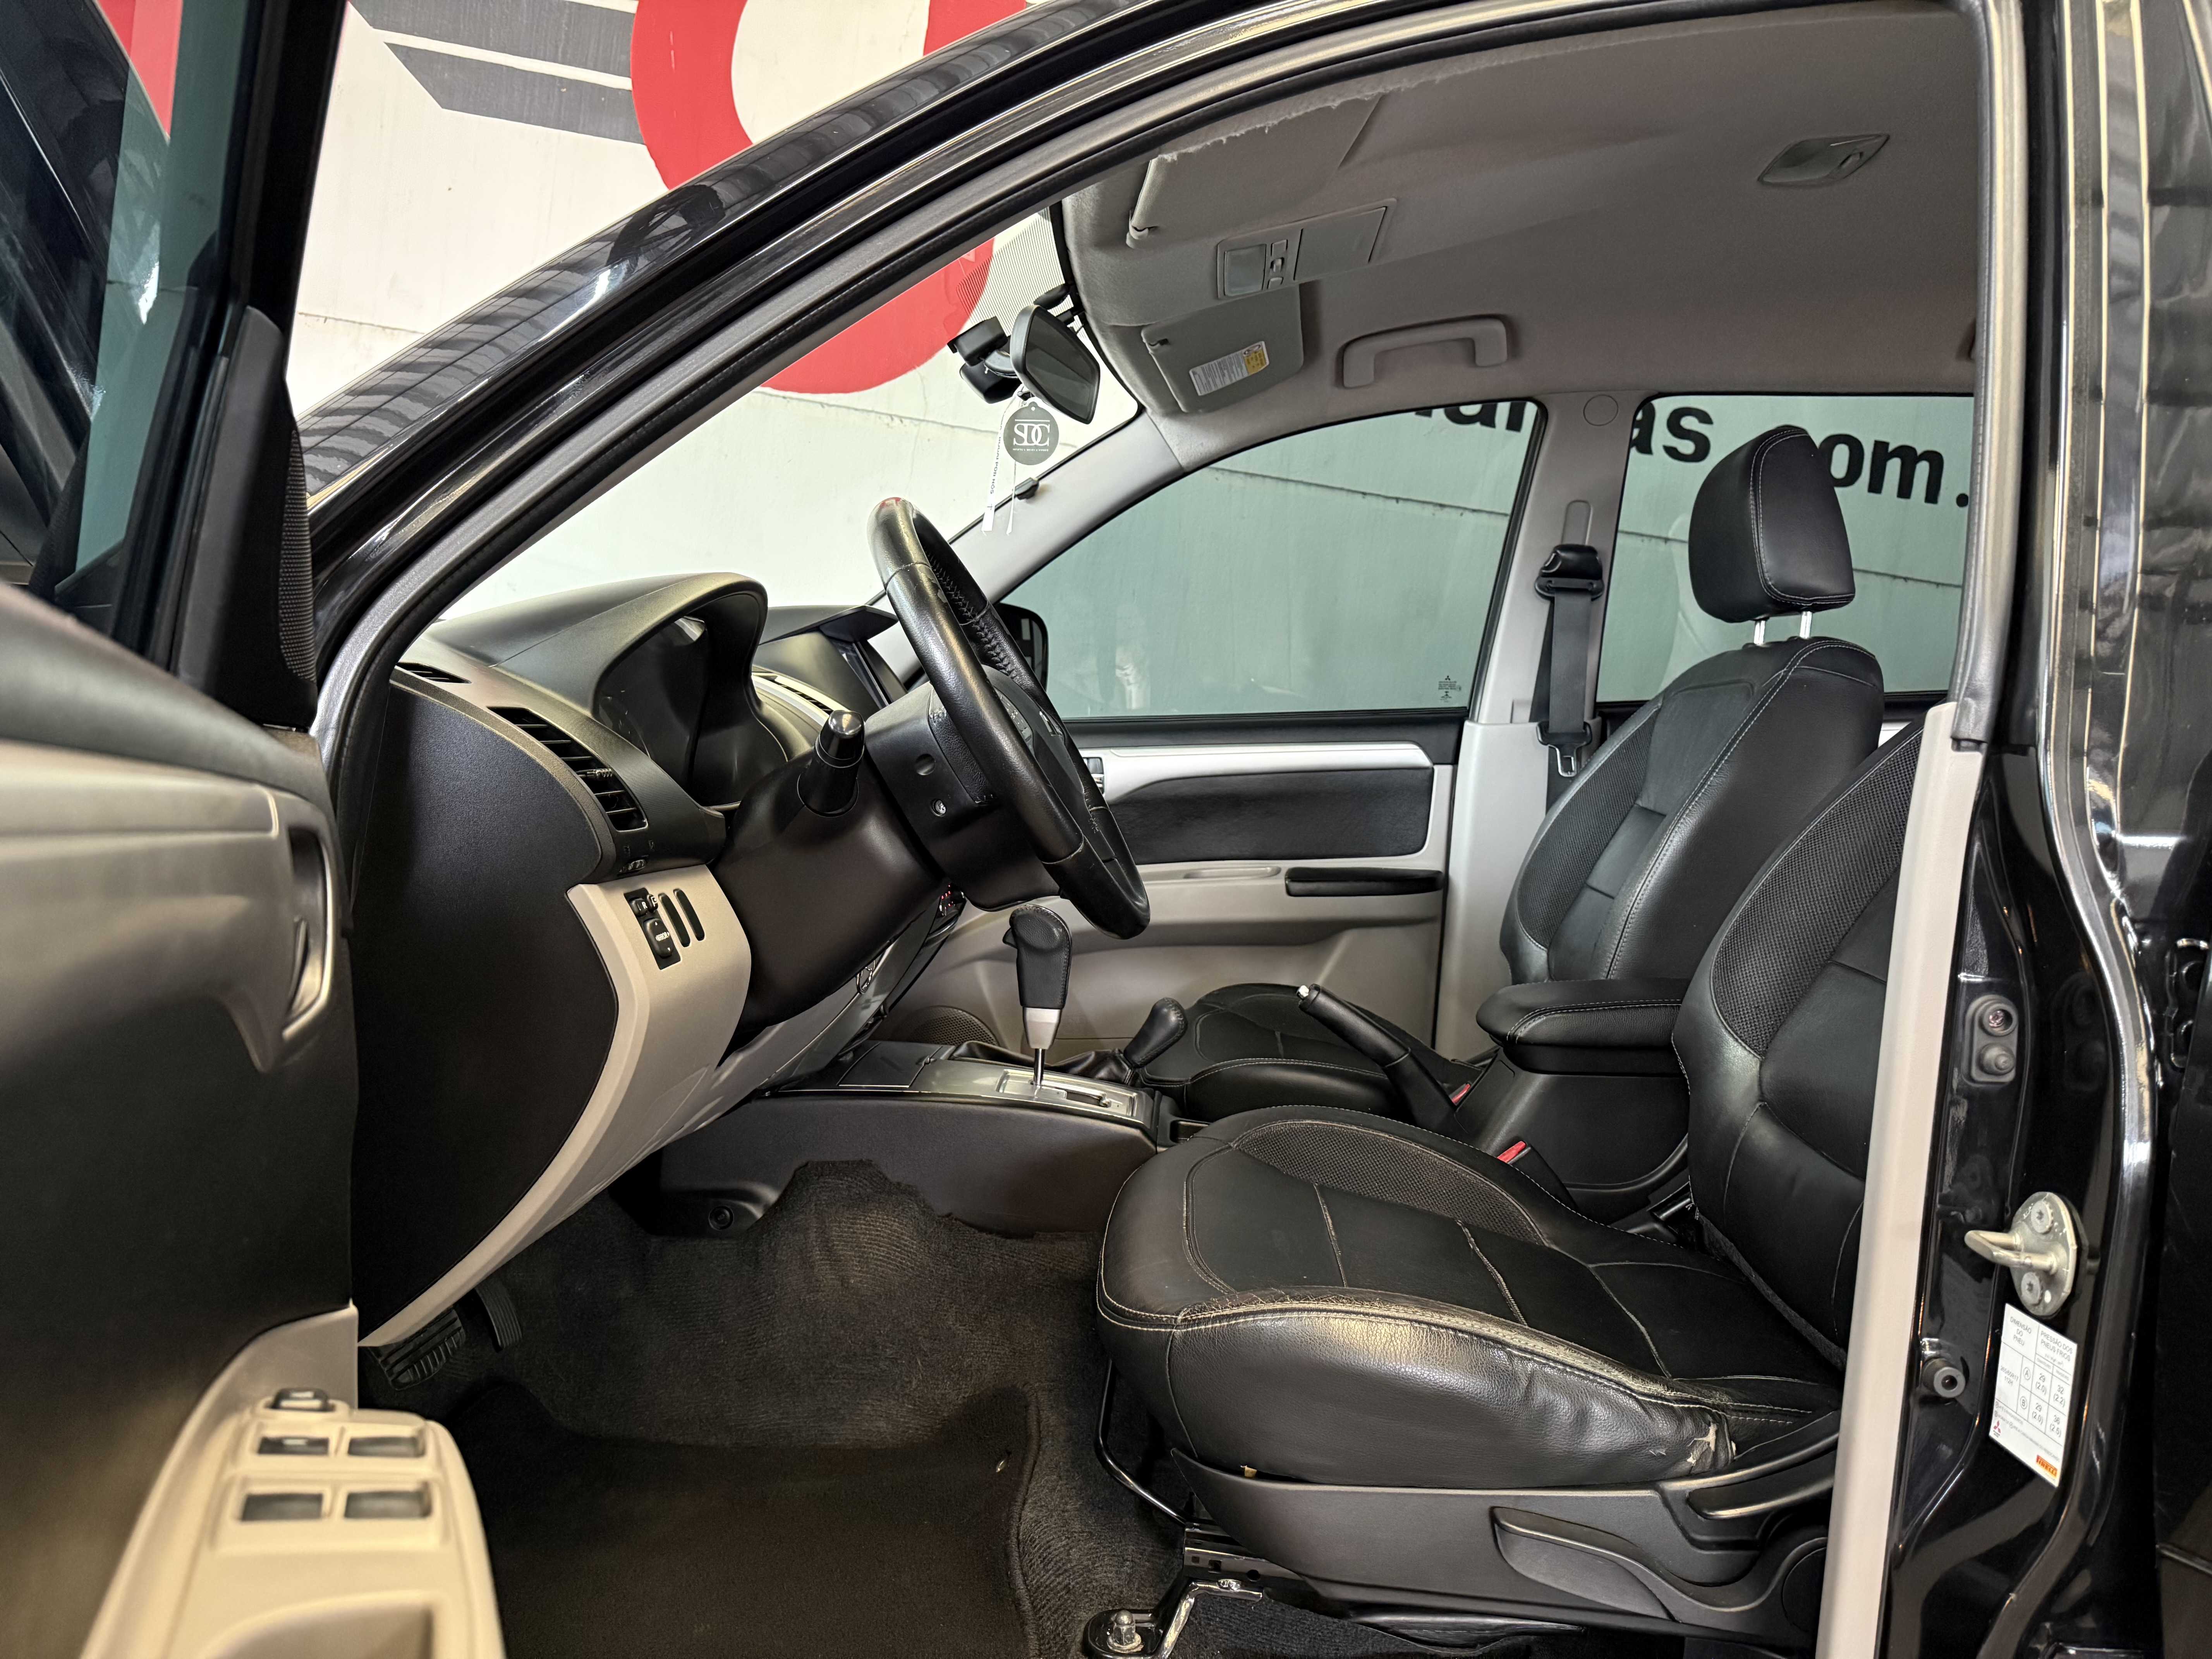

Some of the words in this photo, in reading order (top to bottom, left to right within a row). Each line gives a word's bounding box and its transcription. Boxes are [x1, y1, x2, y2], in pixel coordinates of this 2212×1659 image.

[1013, 423, 1050, 446] SDC
[2010, 1317, 2032, 1334] DIMENSÃO
[2013, 1335, 2025, 1346] PNEU
[2041, 1331, 2062, 1348] PRESSÃO
[2062, 1344, 2073, 1354] DOS
[2041, 1339, 2056, 1353] PNEUS
[2056, 1349, 2070, 1362] FRIOS
[2039, 1373, 2045, 1382] 29
[2057, 1384, 2064, 1395] 32
[2035, 1403, 2042, 1412] 29
